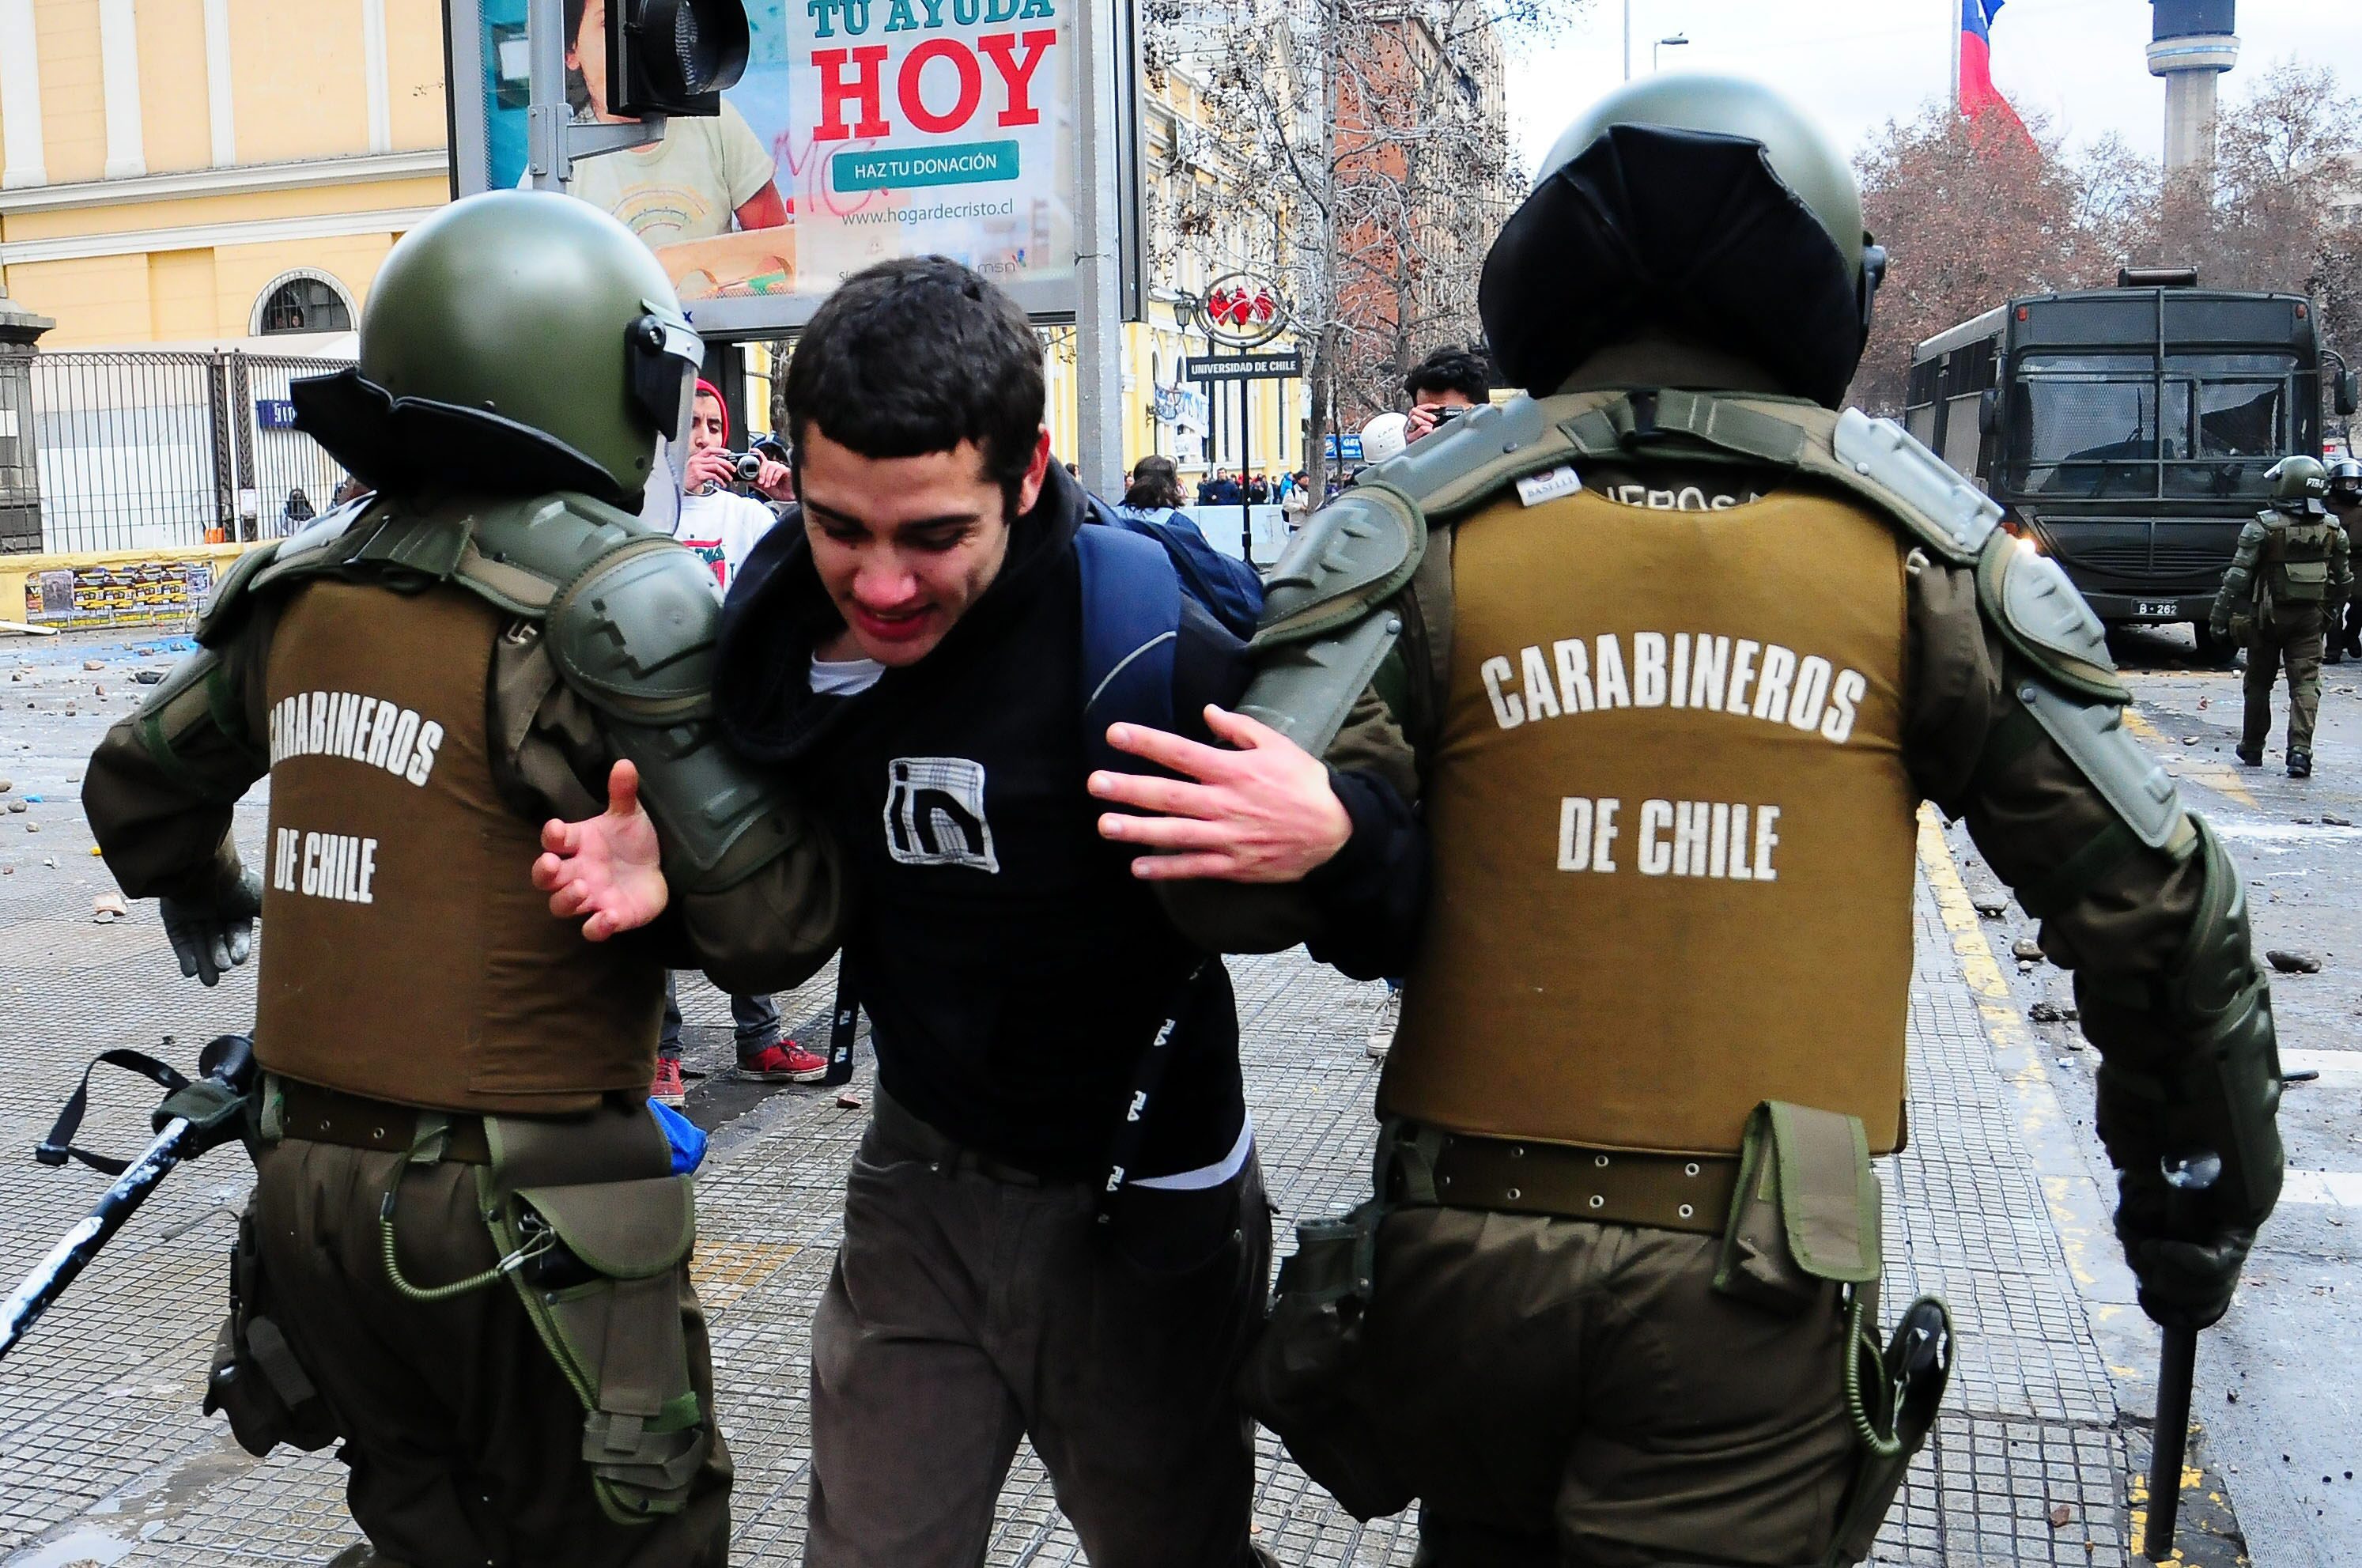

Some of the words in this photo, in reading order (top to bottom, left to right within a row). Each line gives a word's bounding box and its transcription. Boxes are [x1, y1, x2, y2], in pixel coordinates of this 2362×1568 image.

[808, 0, 871, 38] TU
[884, 0, 1056, 32] AYUDA
[811, 29, 1056, 142] HOY
[855, 162, 887, 179] HAZ
[890, 161, 910, 176] TU
[913, 152, 997, 176] DONACIÓN
[841, 198, 1014, 225] www.hogardecristo.cl
[977, 262, 1016, 273] msn
[1191, 362, 1253, 375] UNIVERSIDAD
[1254, 361, 1268, 372] DE
[1269, 360, 1297, 372] CHILE
[1480, 631, 1867, 745] CARABINEROS
[1557, 795, 1620, 874] DE
[1637, 798, 1782, 882] CHILE
[274, 827, 300, 892] DE
[302, 831, 378, 904] CHILE
[1127, 1090, 1147, 1121] FILA
